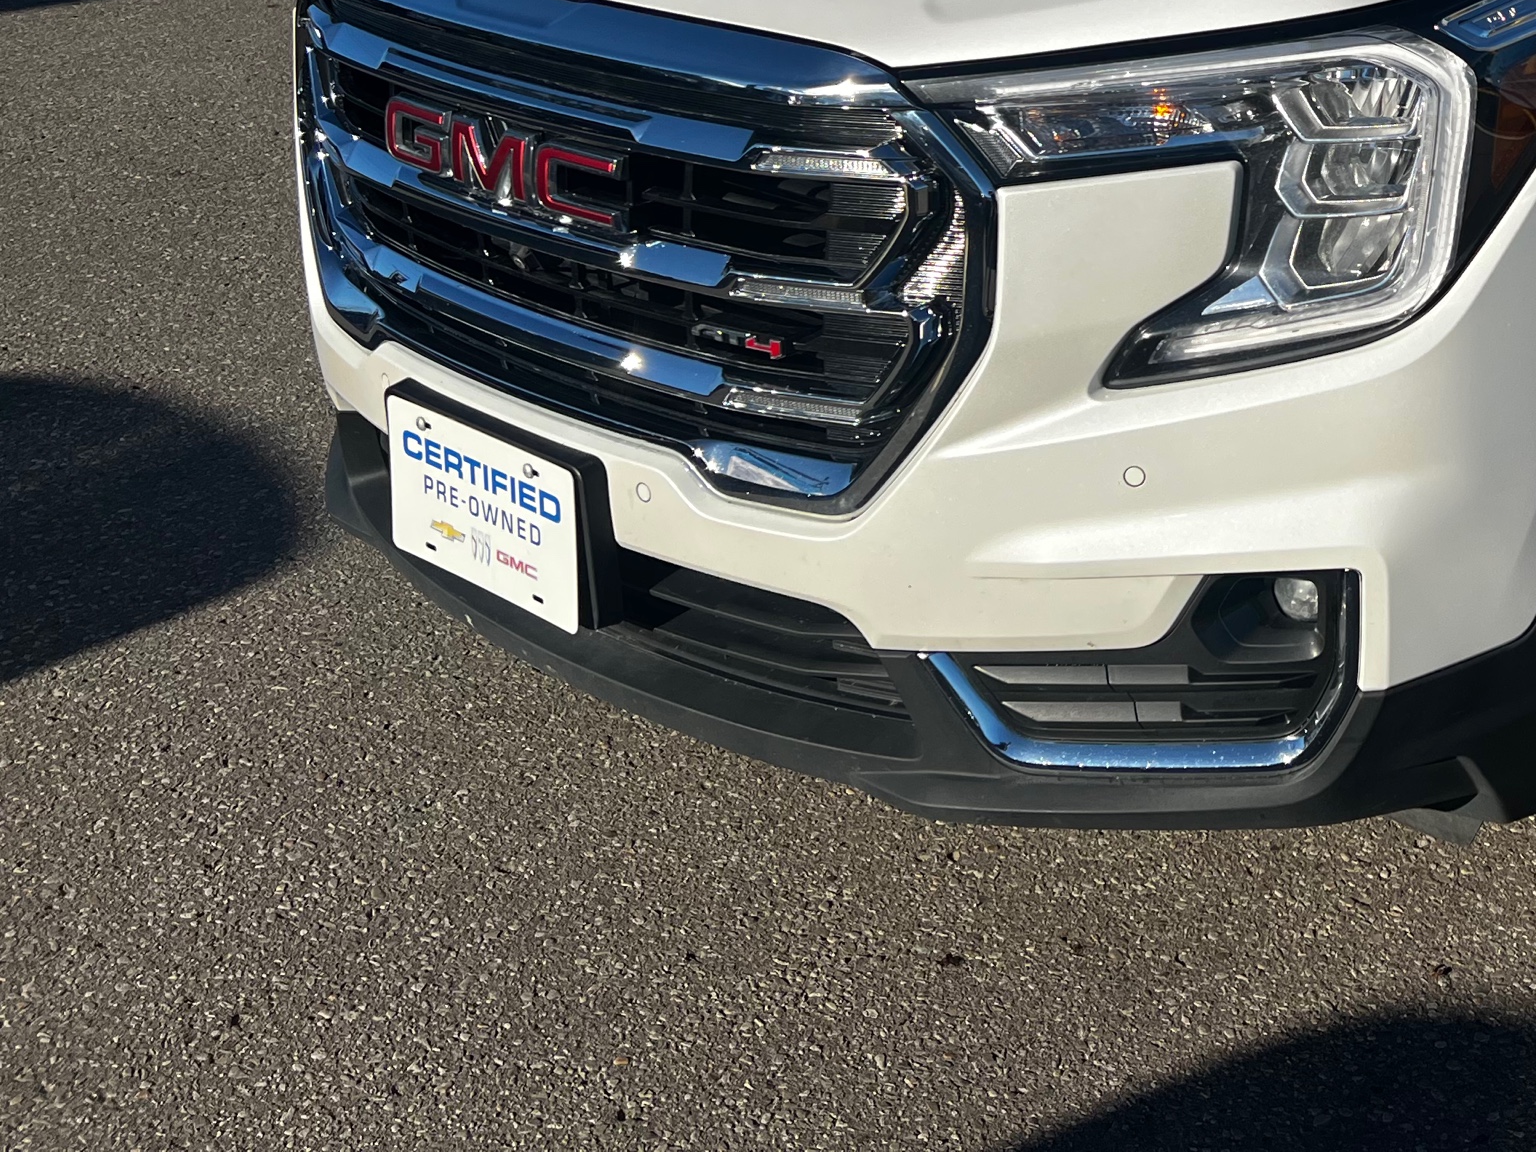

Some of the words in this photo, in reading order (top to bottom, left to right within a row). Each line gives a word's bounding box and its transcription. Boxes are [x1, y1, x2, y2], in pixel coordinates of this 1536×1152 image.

[384, 92, 630, 234] GMC
[690, 323, 786, 360] AT4
[402, 429, 562, 524] CERTIFIED
[423, 474, 542, 547] PRE-OWNED
[496, 549, 539, 581] GMC
